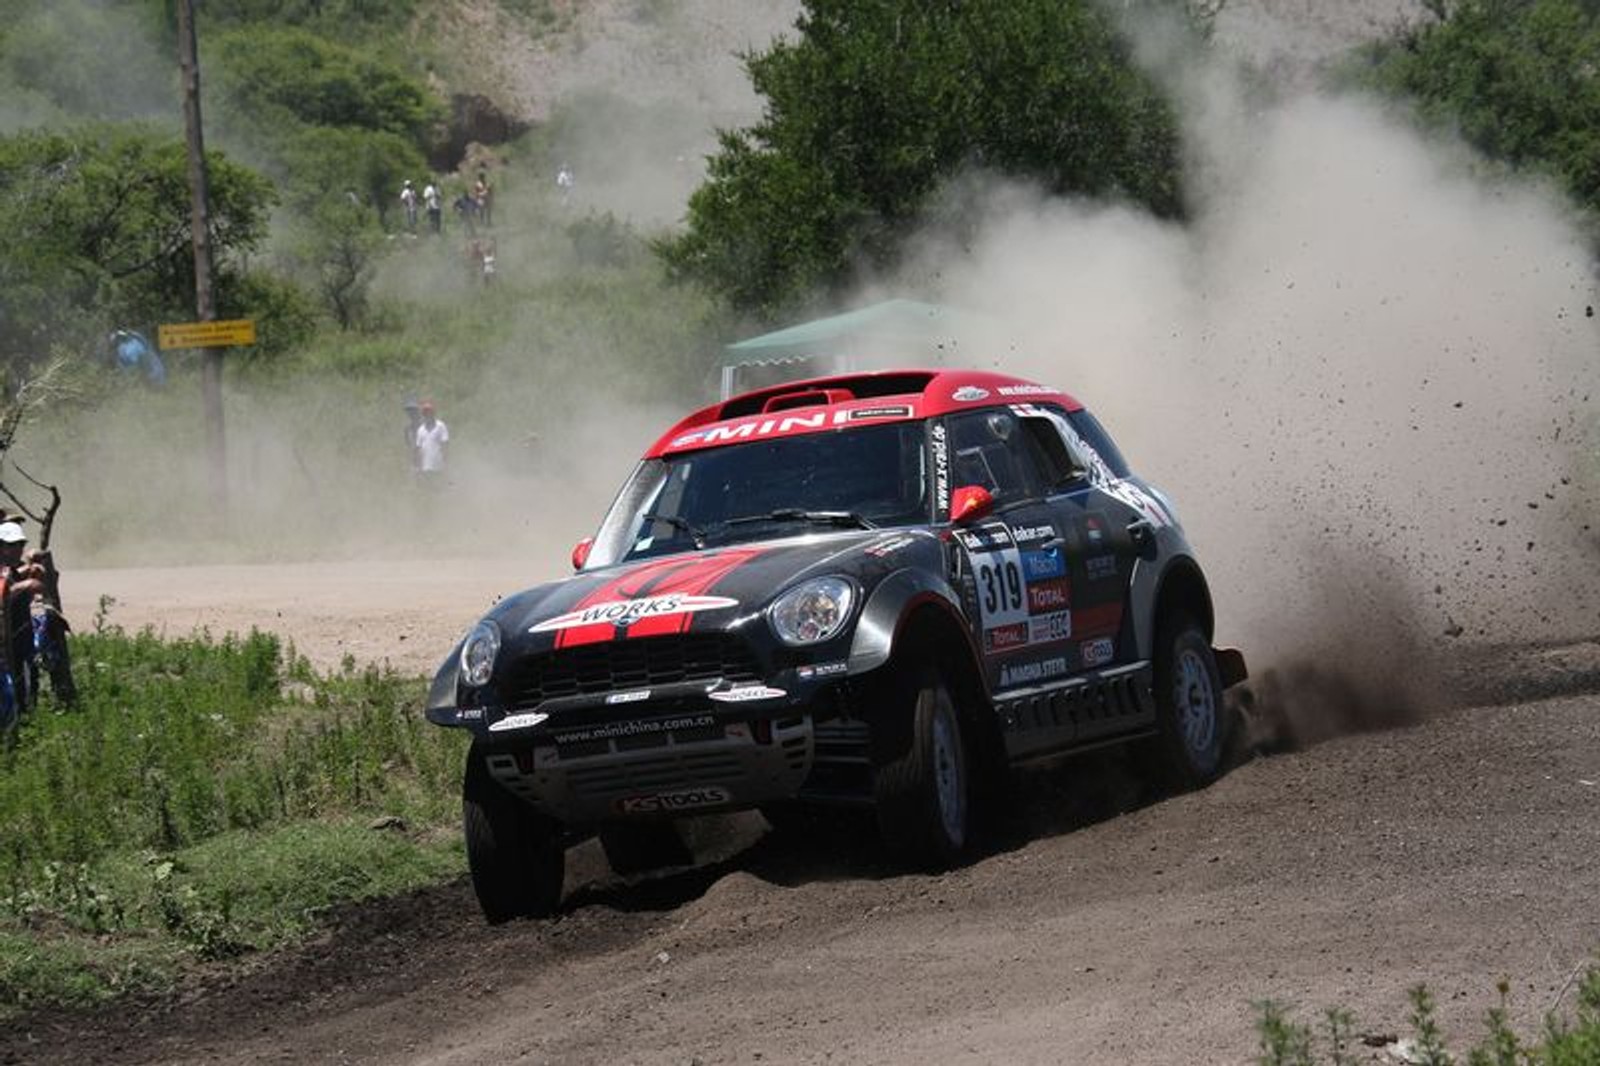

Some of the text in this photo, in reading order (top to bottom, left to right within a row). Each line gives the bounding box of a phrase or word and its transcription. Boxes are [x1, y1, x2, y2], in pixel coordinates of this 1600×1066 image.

[702, 410, 849, 441] MINI
[981, 562, 1021, 614] 319
[581, 595, 682, 622] WORKS
[555, 716, 714, 744] www.minichina.com.cn
